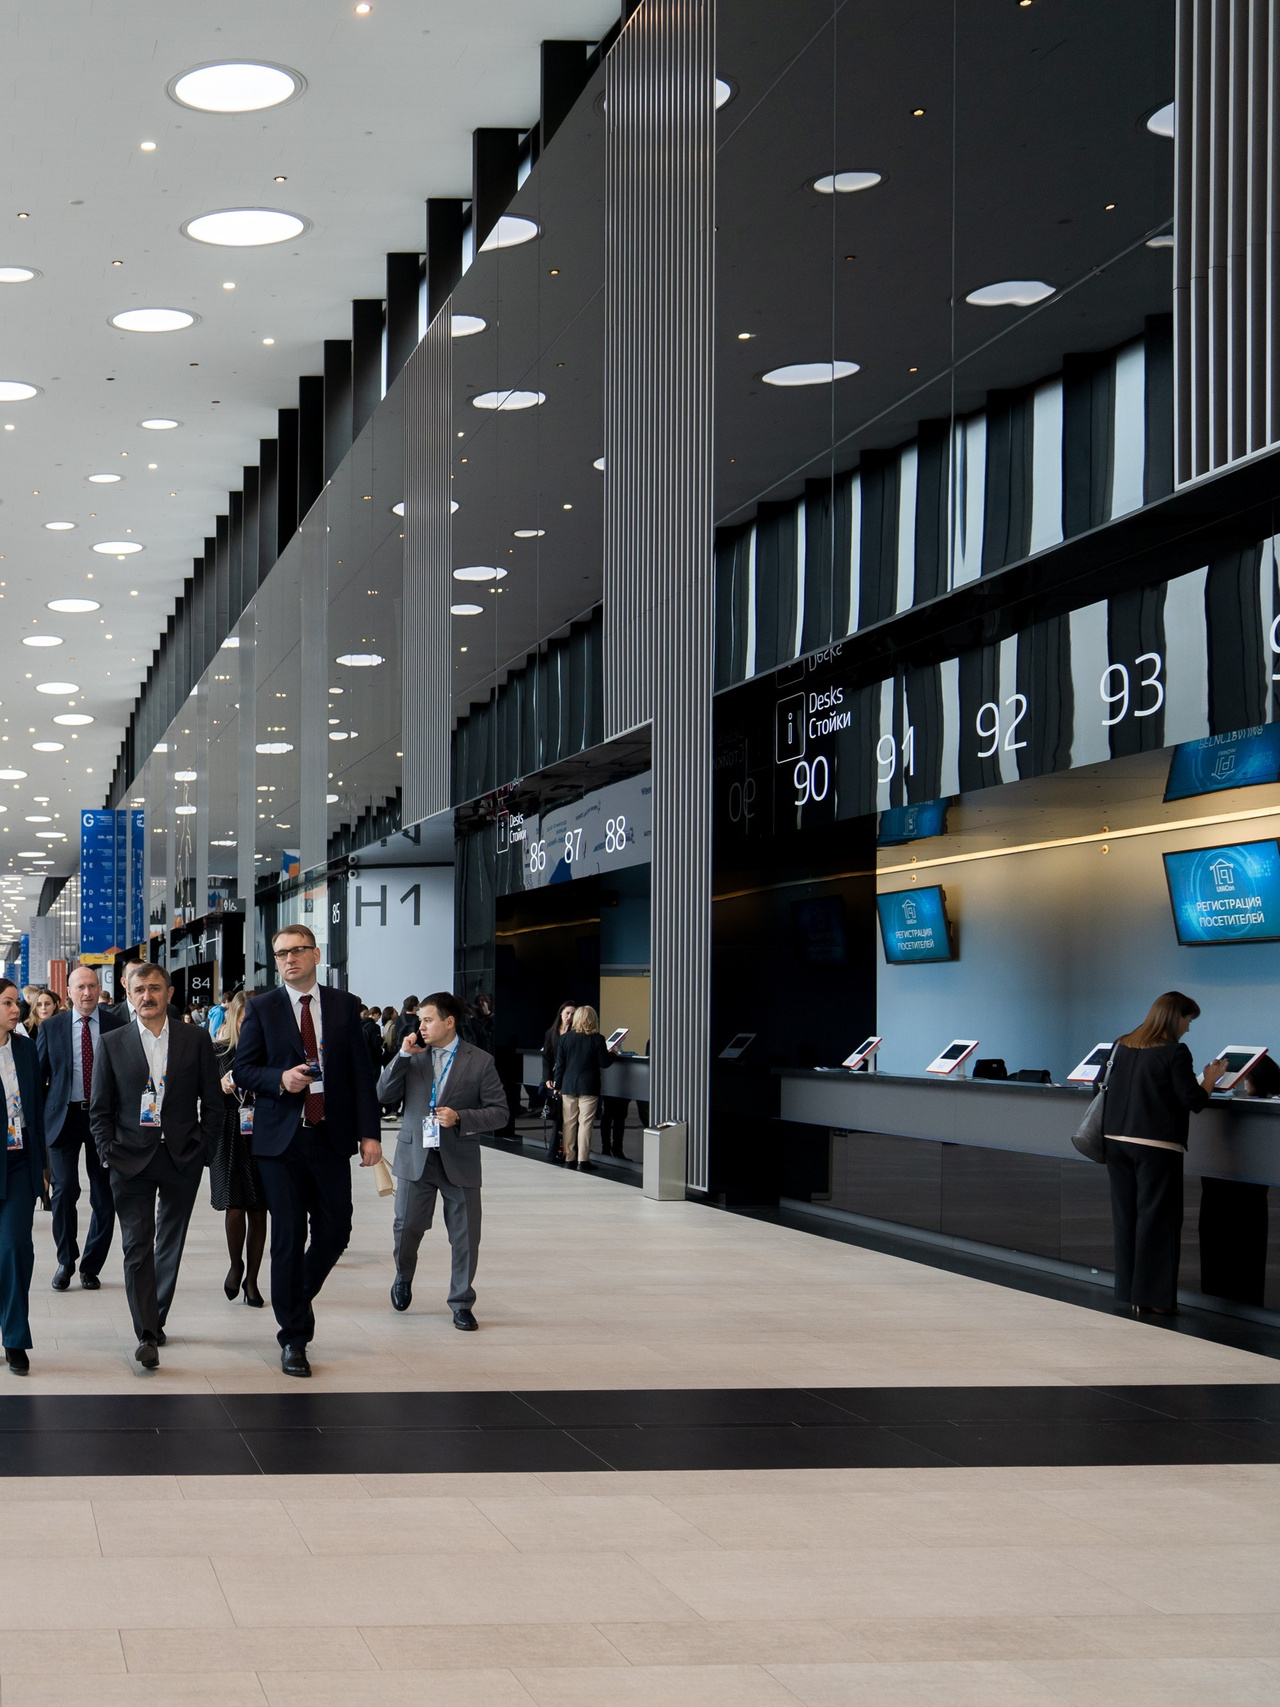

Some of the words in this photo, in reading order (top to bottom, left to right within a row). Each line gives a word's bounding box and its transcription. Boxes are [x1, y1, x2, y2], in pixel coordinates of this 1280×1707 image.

[809, 686, 844, 714] Desks
[1099, 652, 1165, 726] 93
[809, 711, 851, 739] Стойки
[975, 693, 1028, 758] 92
[876, 725, 915, 784] 91
[793, 755, 829, 806] 90
[83, 813, 94, 827] G
[509, 813, 524, 828] Desks
[509, 828, 527, 844] Стойки
[564, 828, 583, 864] 87
[605, 815, 627, 854] 88
[529, 840, 546, 873] 86
[332, 902, 340, 924] 85
[355, 884, 421, 927] H1
[1196, 896, 1262, 912] РЕГИСТРАЦИЯ
[1199, 911, 1265, 927] ПОСЕТИТЕЛЕЙ
[895, 927, 933, 939] РЕГИСТРАЦИЯ
[898, 939, 935, 950] ПОСЕТИТЕЛЕЙ
[192, 977, 211, 989] 84
[192, 996, 200, 1004] H
